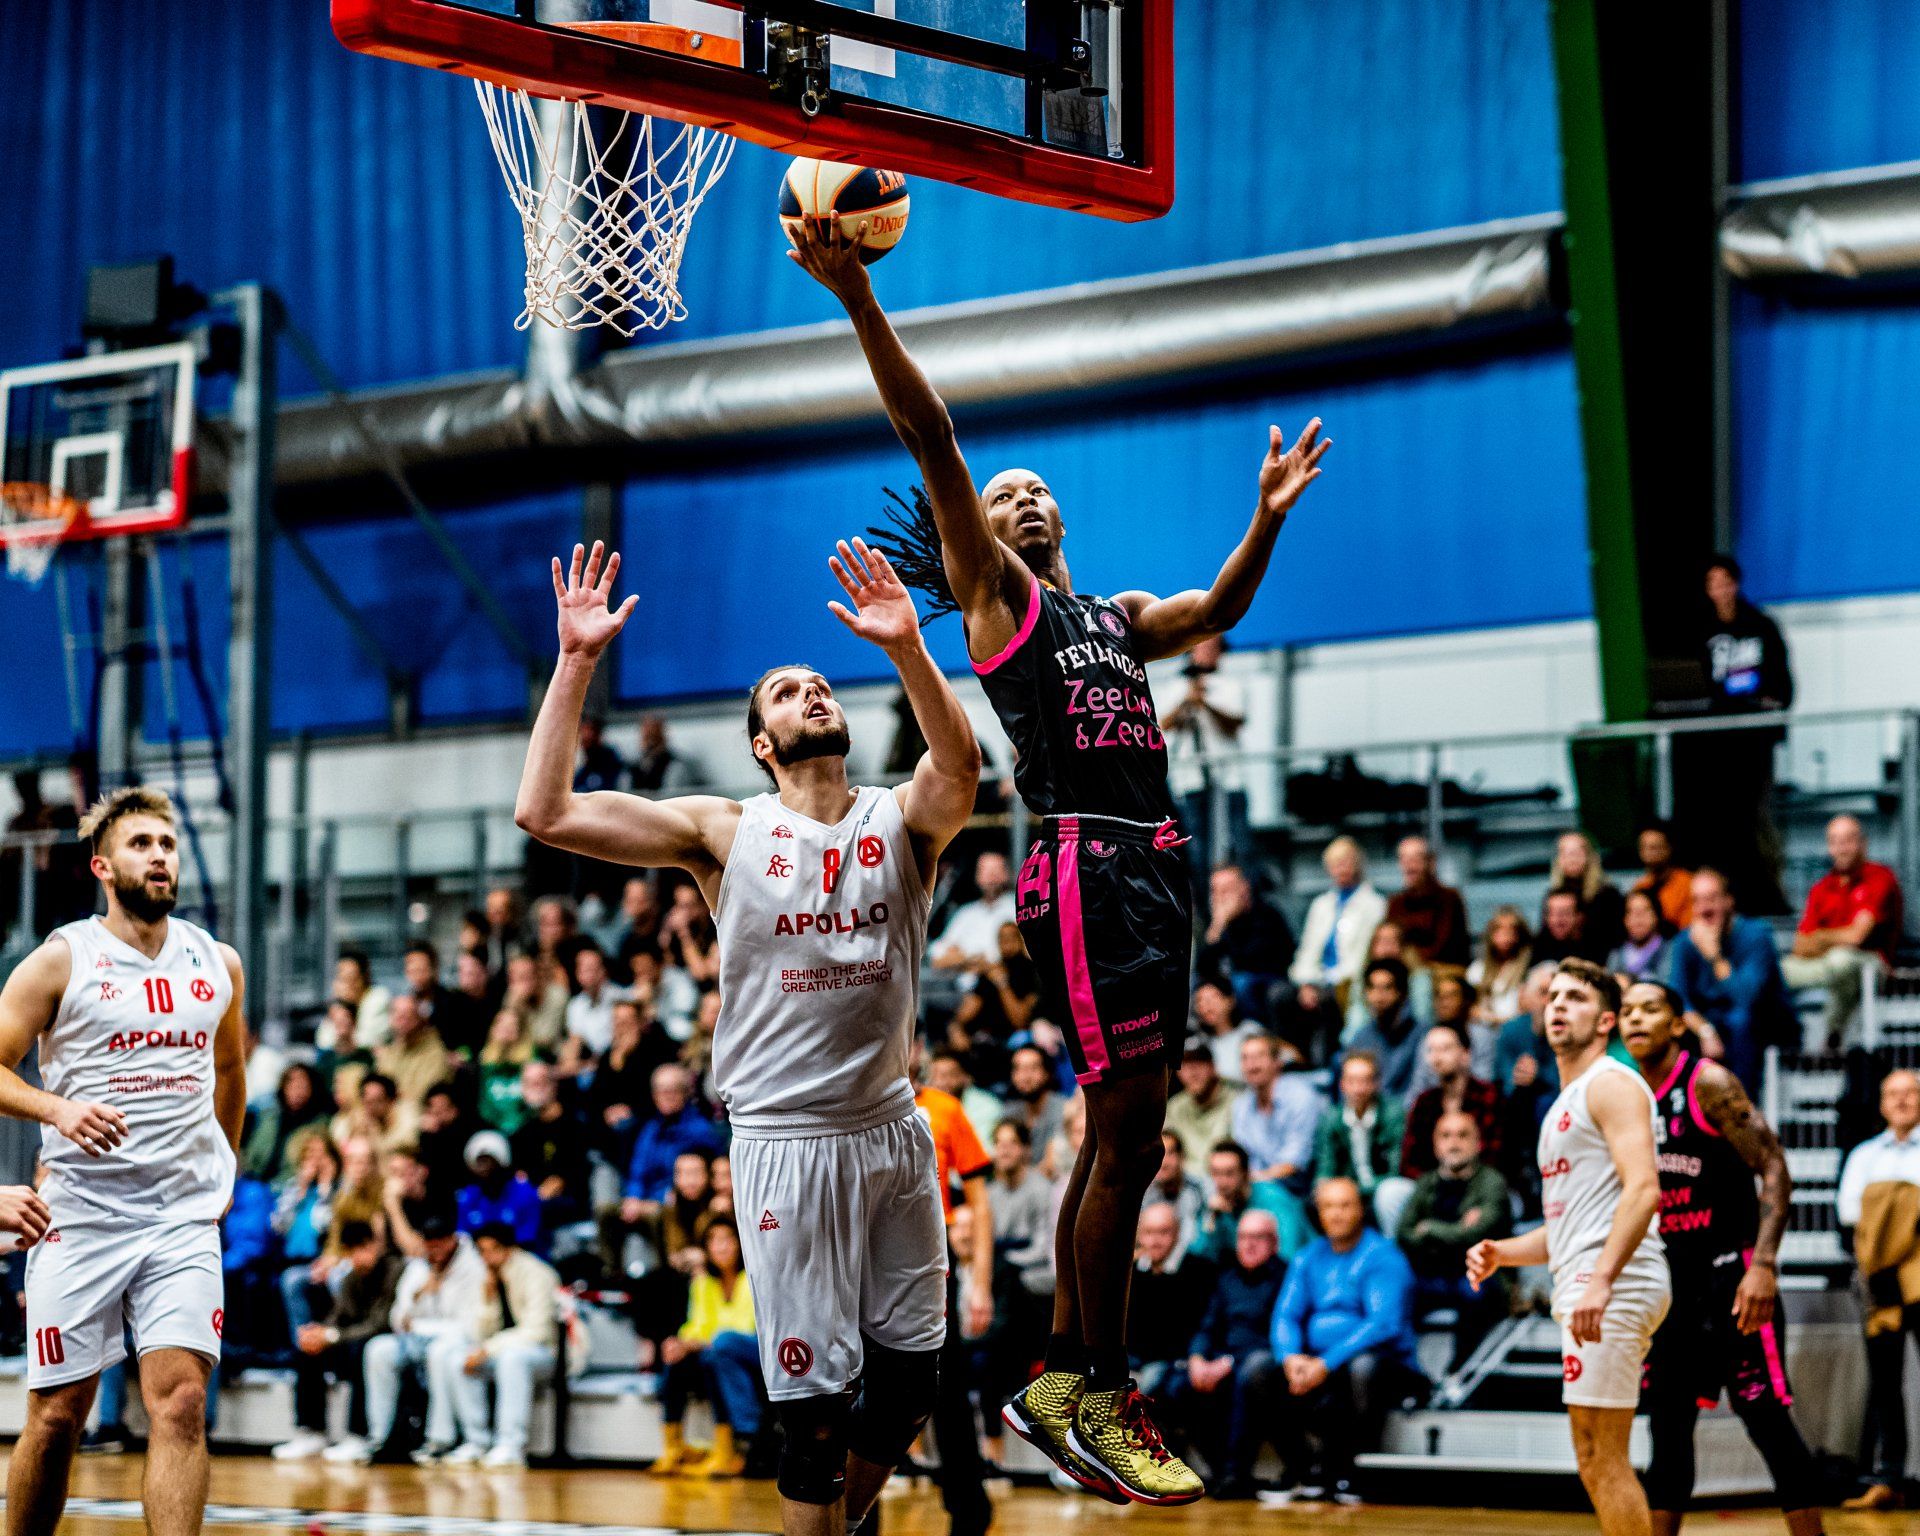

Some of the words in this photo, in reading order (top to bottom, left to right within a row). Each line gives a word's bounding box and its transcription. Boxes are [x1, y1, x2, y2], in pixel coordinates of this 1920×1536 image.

[1075, 722, 1090, 750] &
[771, 830, 794, 839] PEAK
[822, 848, 841, 894] 8
[774, 902, 889, 936] APOLLO
[781, 968, 829, 981] BEHIND
[831, 963, 857, 978] THE
[781, 978, 843, 993] CREATIVE
[844, 969, 893, 989] AGENCY
[142, 977, 174, 1014] 10
[108, 1029, 208, 1051] APOLLO
[1119, 1038, 1164, 1060] TOPSPORT
[759, 1221, 781, 1232] PEAK
[35, 1326, 65, 1367] 10
